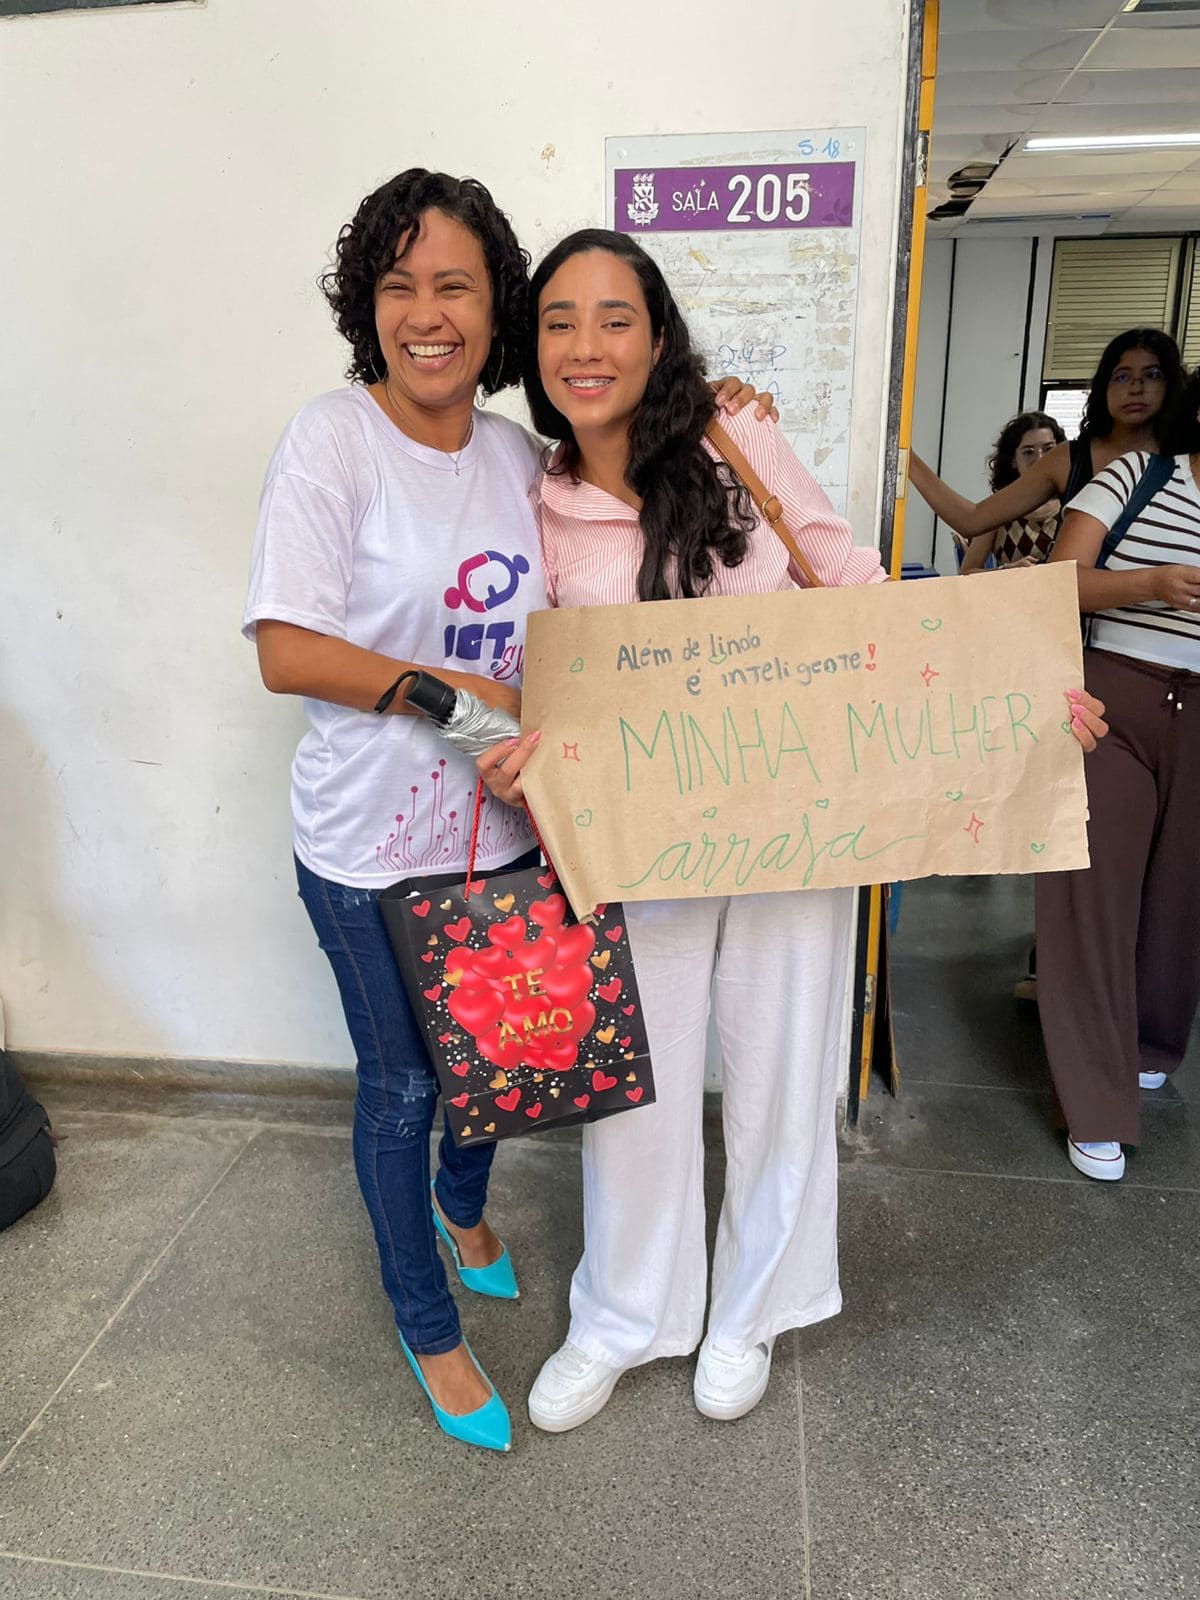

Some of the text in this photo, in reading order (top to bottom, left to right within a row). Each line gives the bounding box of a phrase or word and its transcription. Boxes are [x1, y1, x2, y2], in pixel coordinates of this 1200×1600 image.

[672, 173, 811, 224] SALA 205
[616, 638, 672, 672] Além
[683, 637, 701, 661] de
[619, 693, 1040, 795] MINHA MULHER
[502, 967, 548, 1003] TE
[498, 1007, 573, 1051] AMO
